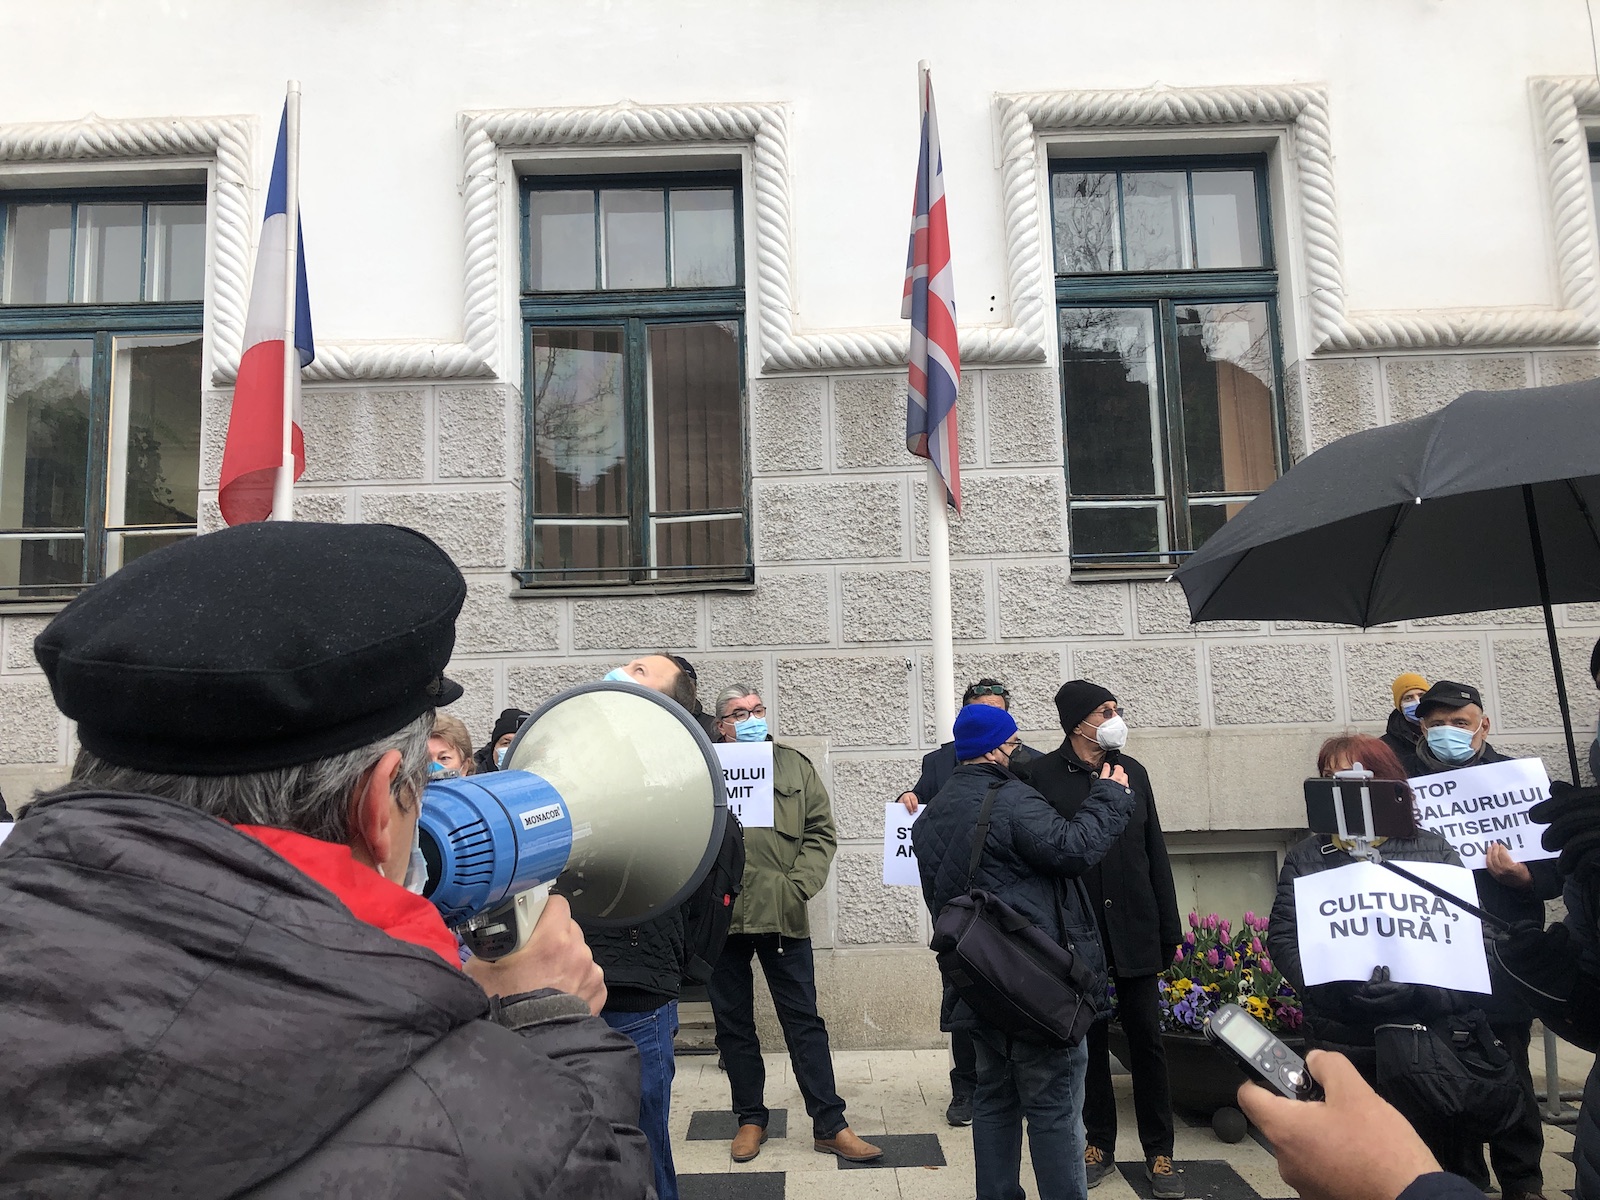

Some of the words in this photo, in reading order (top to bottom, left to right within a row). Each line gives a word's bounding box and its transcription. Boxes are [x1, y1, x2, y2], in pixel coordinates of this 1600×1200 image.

[722, 767, 765, 781] RULUI
[726, 786, 754, 799] MIT
[1413, 780, 1457, 800] TOP
[1412, 786, 1543, 821] BALAURULUI
[524, 808, 560, 826] MONACOR
[1429, 810, 1530, 839] NTISEMIT
[1329, 916, 1369, 939] NU
[1376, 915, 1438, 943] URĂ
[1218, 1010, 1232, 1025] SONY
